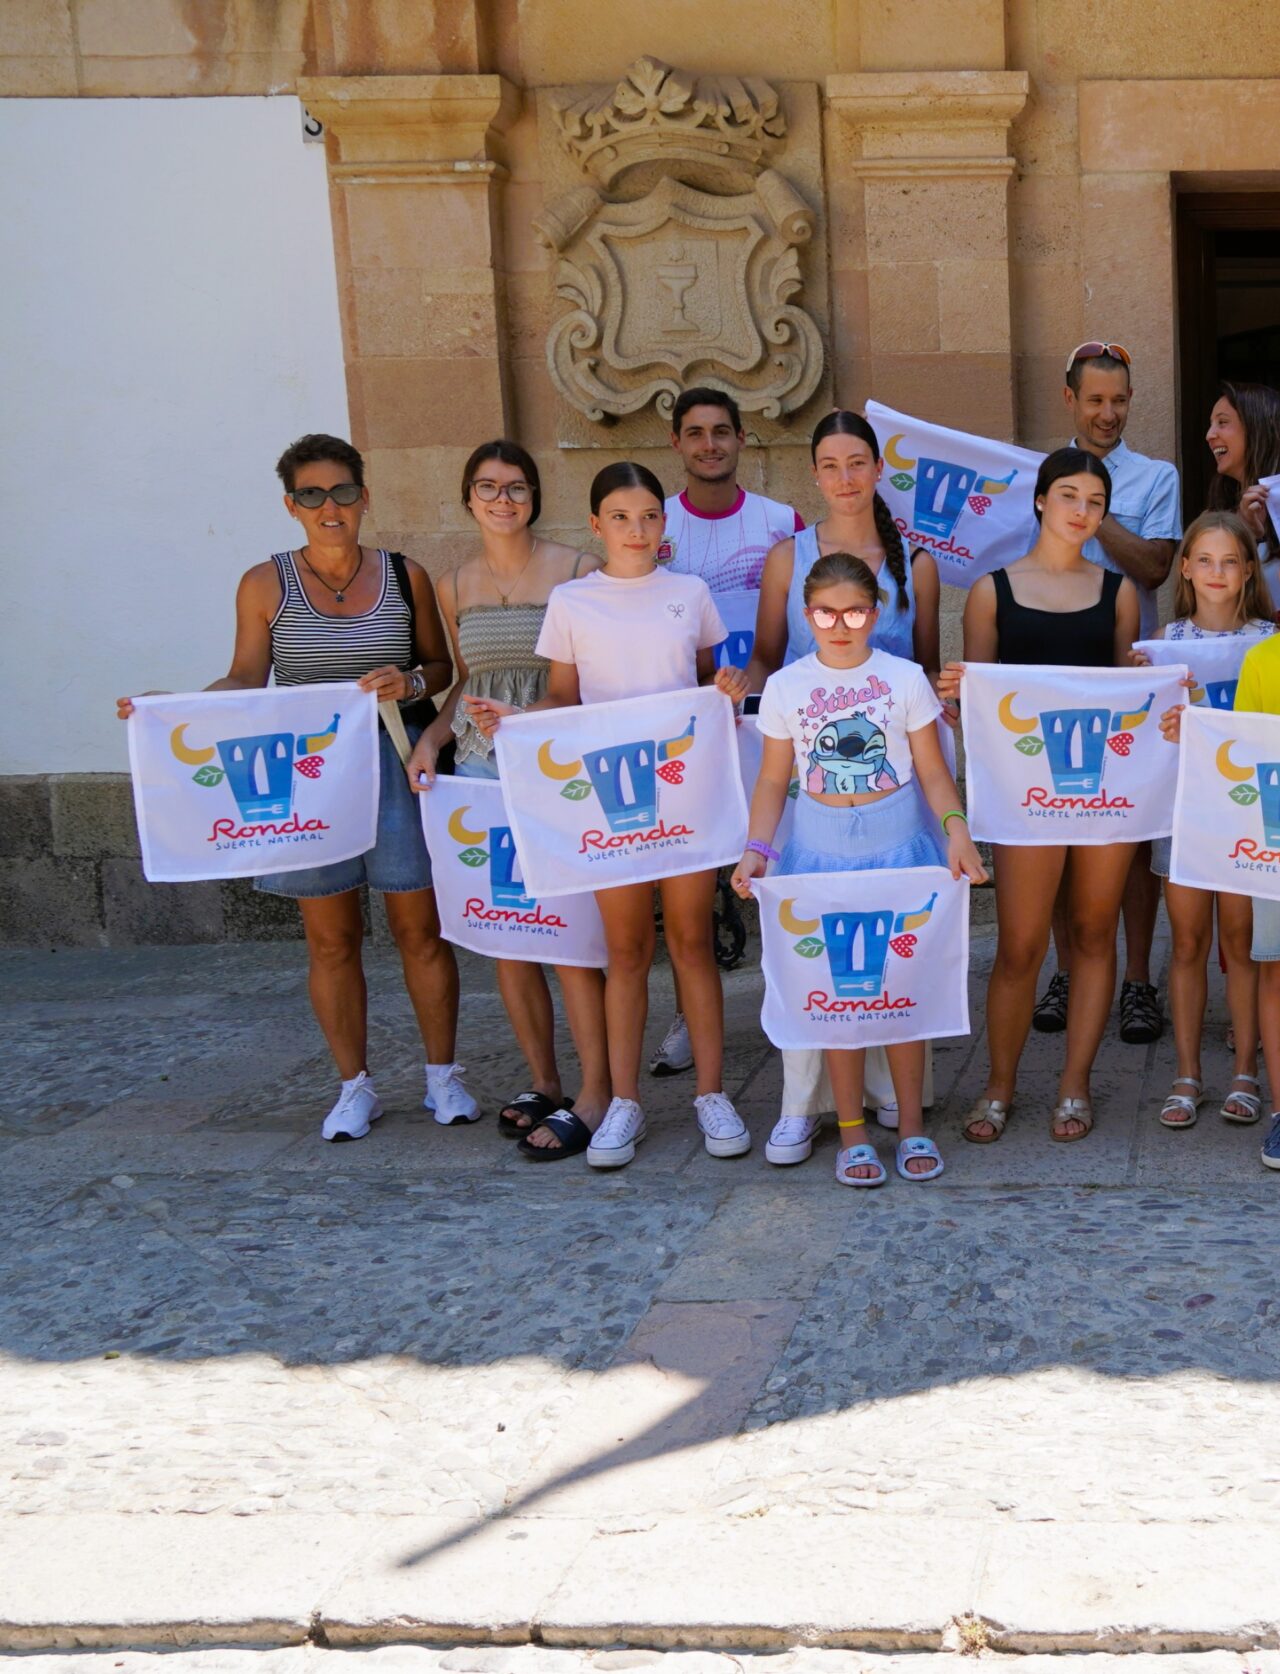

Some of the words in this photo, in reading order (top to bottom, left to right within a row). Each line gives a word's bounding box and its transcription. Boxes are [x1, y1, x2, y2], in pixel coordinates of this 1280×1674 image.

[806, 674, 892, 718] Stitch
[1021, 787, 1135, 809] Ronda
[1027, 809, 1070, 818] SUERTE
[1075, 810, 1128, 818] NATURAL
[207, 812, 330, 842] Ronda
[578, 819, 695, 854] Ronda
[215, 840, 262, 851] SUERTE
[267, 833, 324, 845] NATURAL
[587, 848, 630, 862] SUERTE
[635, 837, 689, 853] NATURAL
[1234, 860, 1278, 873] SUERTE
[462, 897, 568, 928] Ronda
[467, 919, 503, 931] SUERTE
[508, 924, 559, 937] NATURAL
[802, 990, 917, 1013] Ronda
[810, 1012, 852, 1023] SUERTE
[857, 1010, 911, 1021] NATURAL
